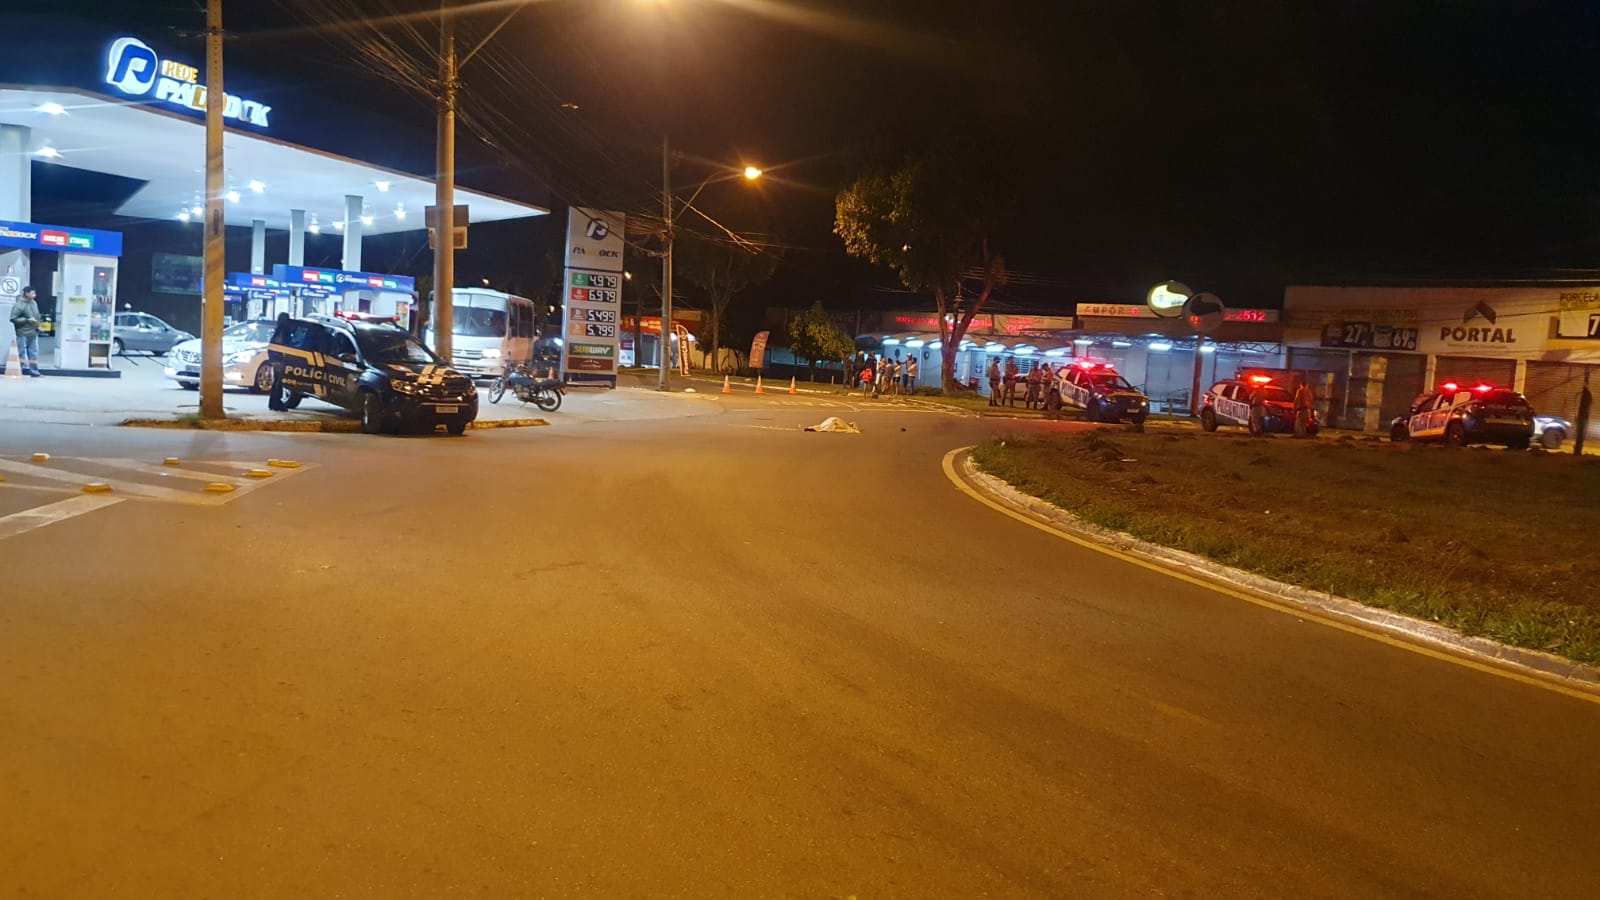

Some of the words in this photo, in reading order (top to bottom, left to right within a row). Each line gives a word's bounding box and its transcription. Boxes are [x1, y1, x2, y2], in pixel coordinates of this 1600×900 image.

[163, 60, 198, 84] REDE
[155, 78, 272, 128] PADOCK
[1440, 326, 1516, 343] PORTAL
[574, 345, 611, 355] SUBWAY
[328, 374, 346, 388] CIVIL
